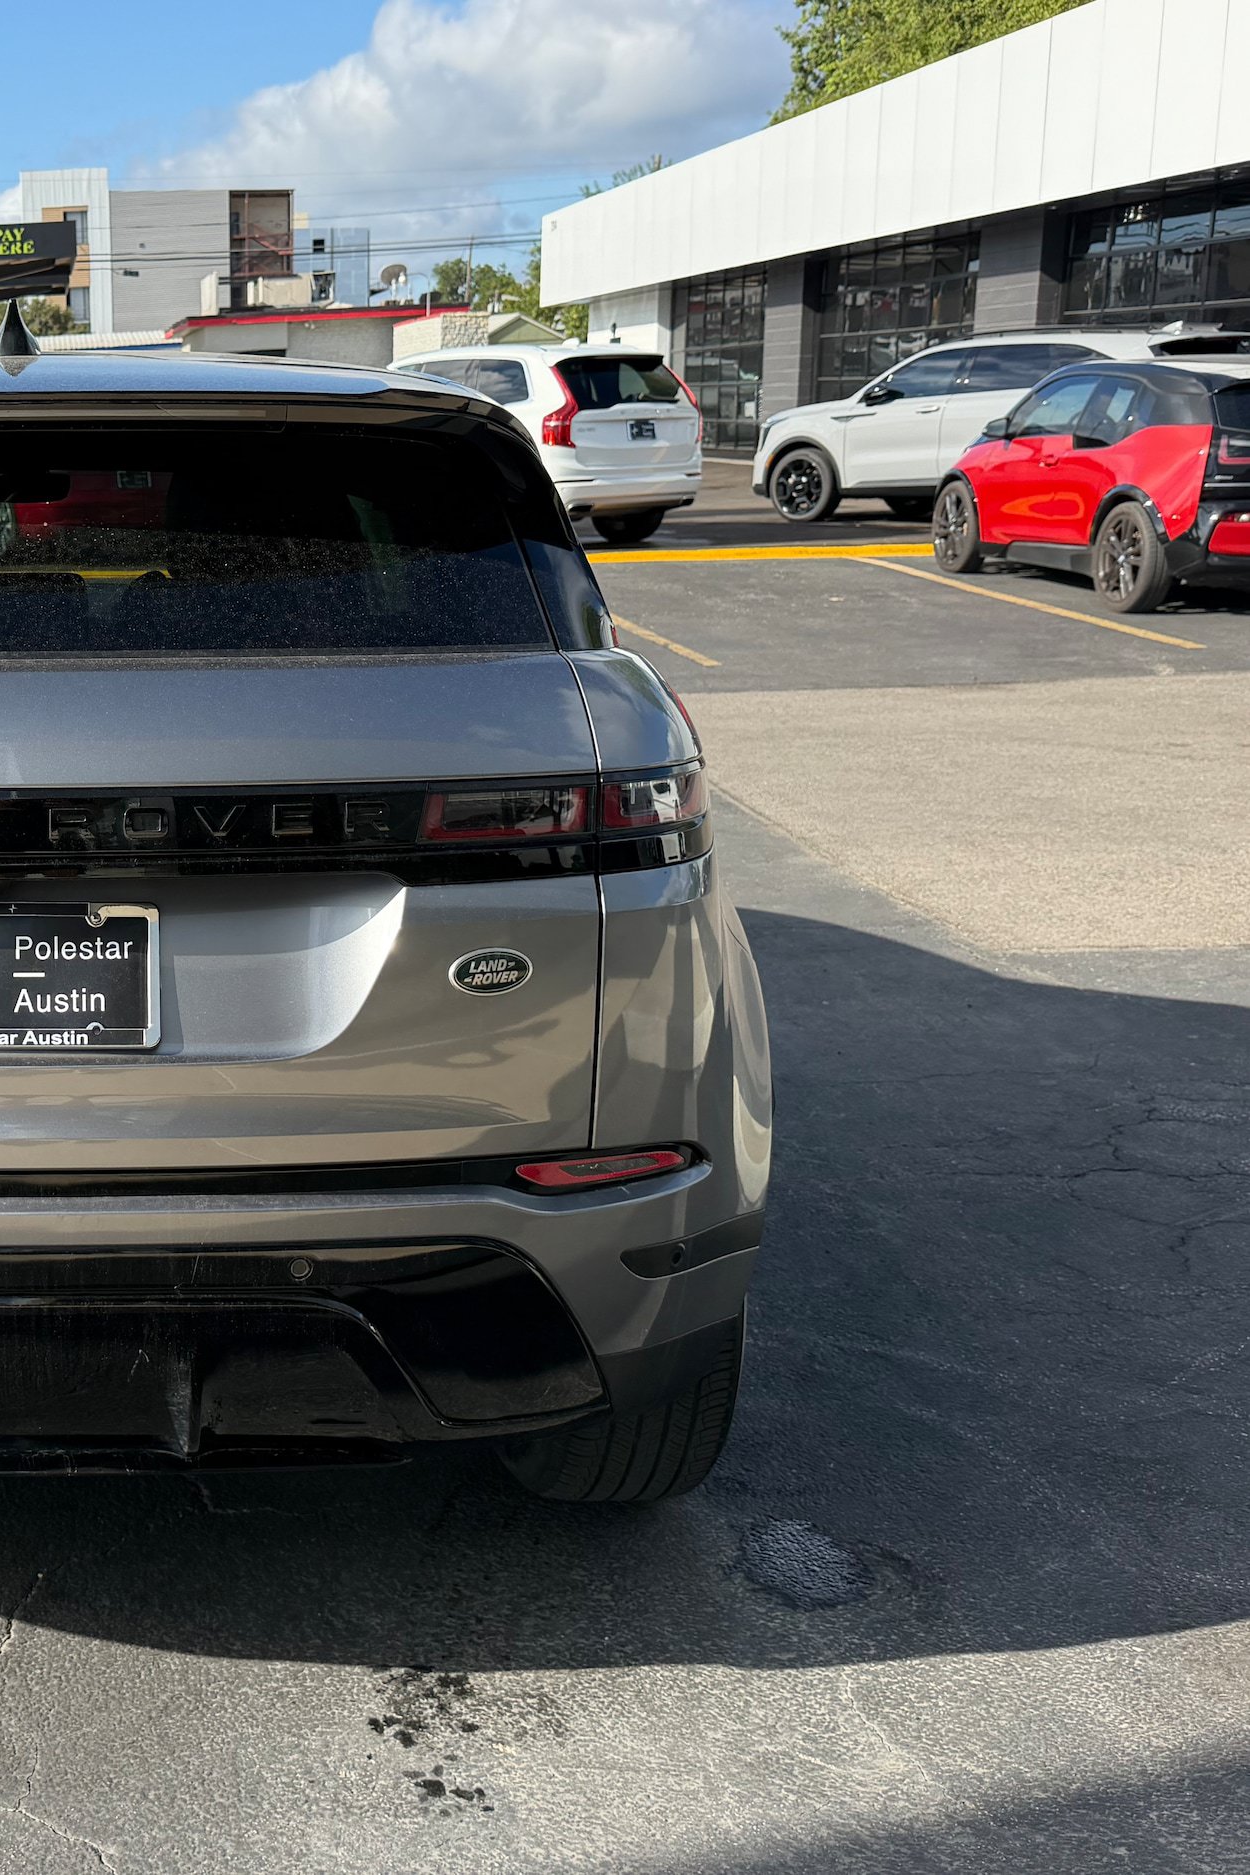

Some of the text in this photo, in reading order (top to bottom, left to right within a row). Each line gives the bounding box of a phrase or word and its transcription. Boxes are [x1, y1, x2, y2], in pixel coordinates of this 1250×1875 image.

[49, 801, 390, 841] ROVER
[14, 935, 134, 961] Polestar
[468, 958, 508, 974] LAND
[471, 970, 519, 986] ROVER
[13, 987, 106, 1014] Austin
[23, 1030, 89, 1046] Austin
